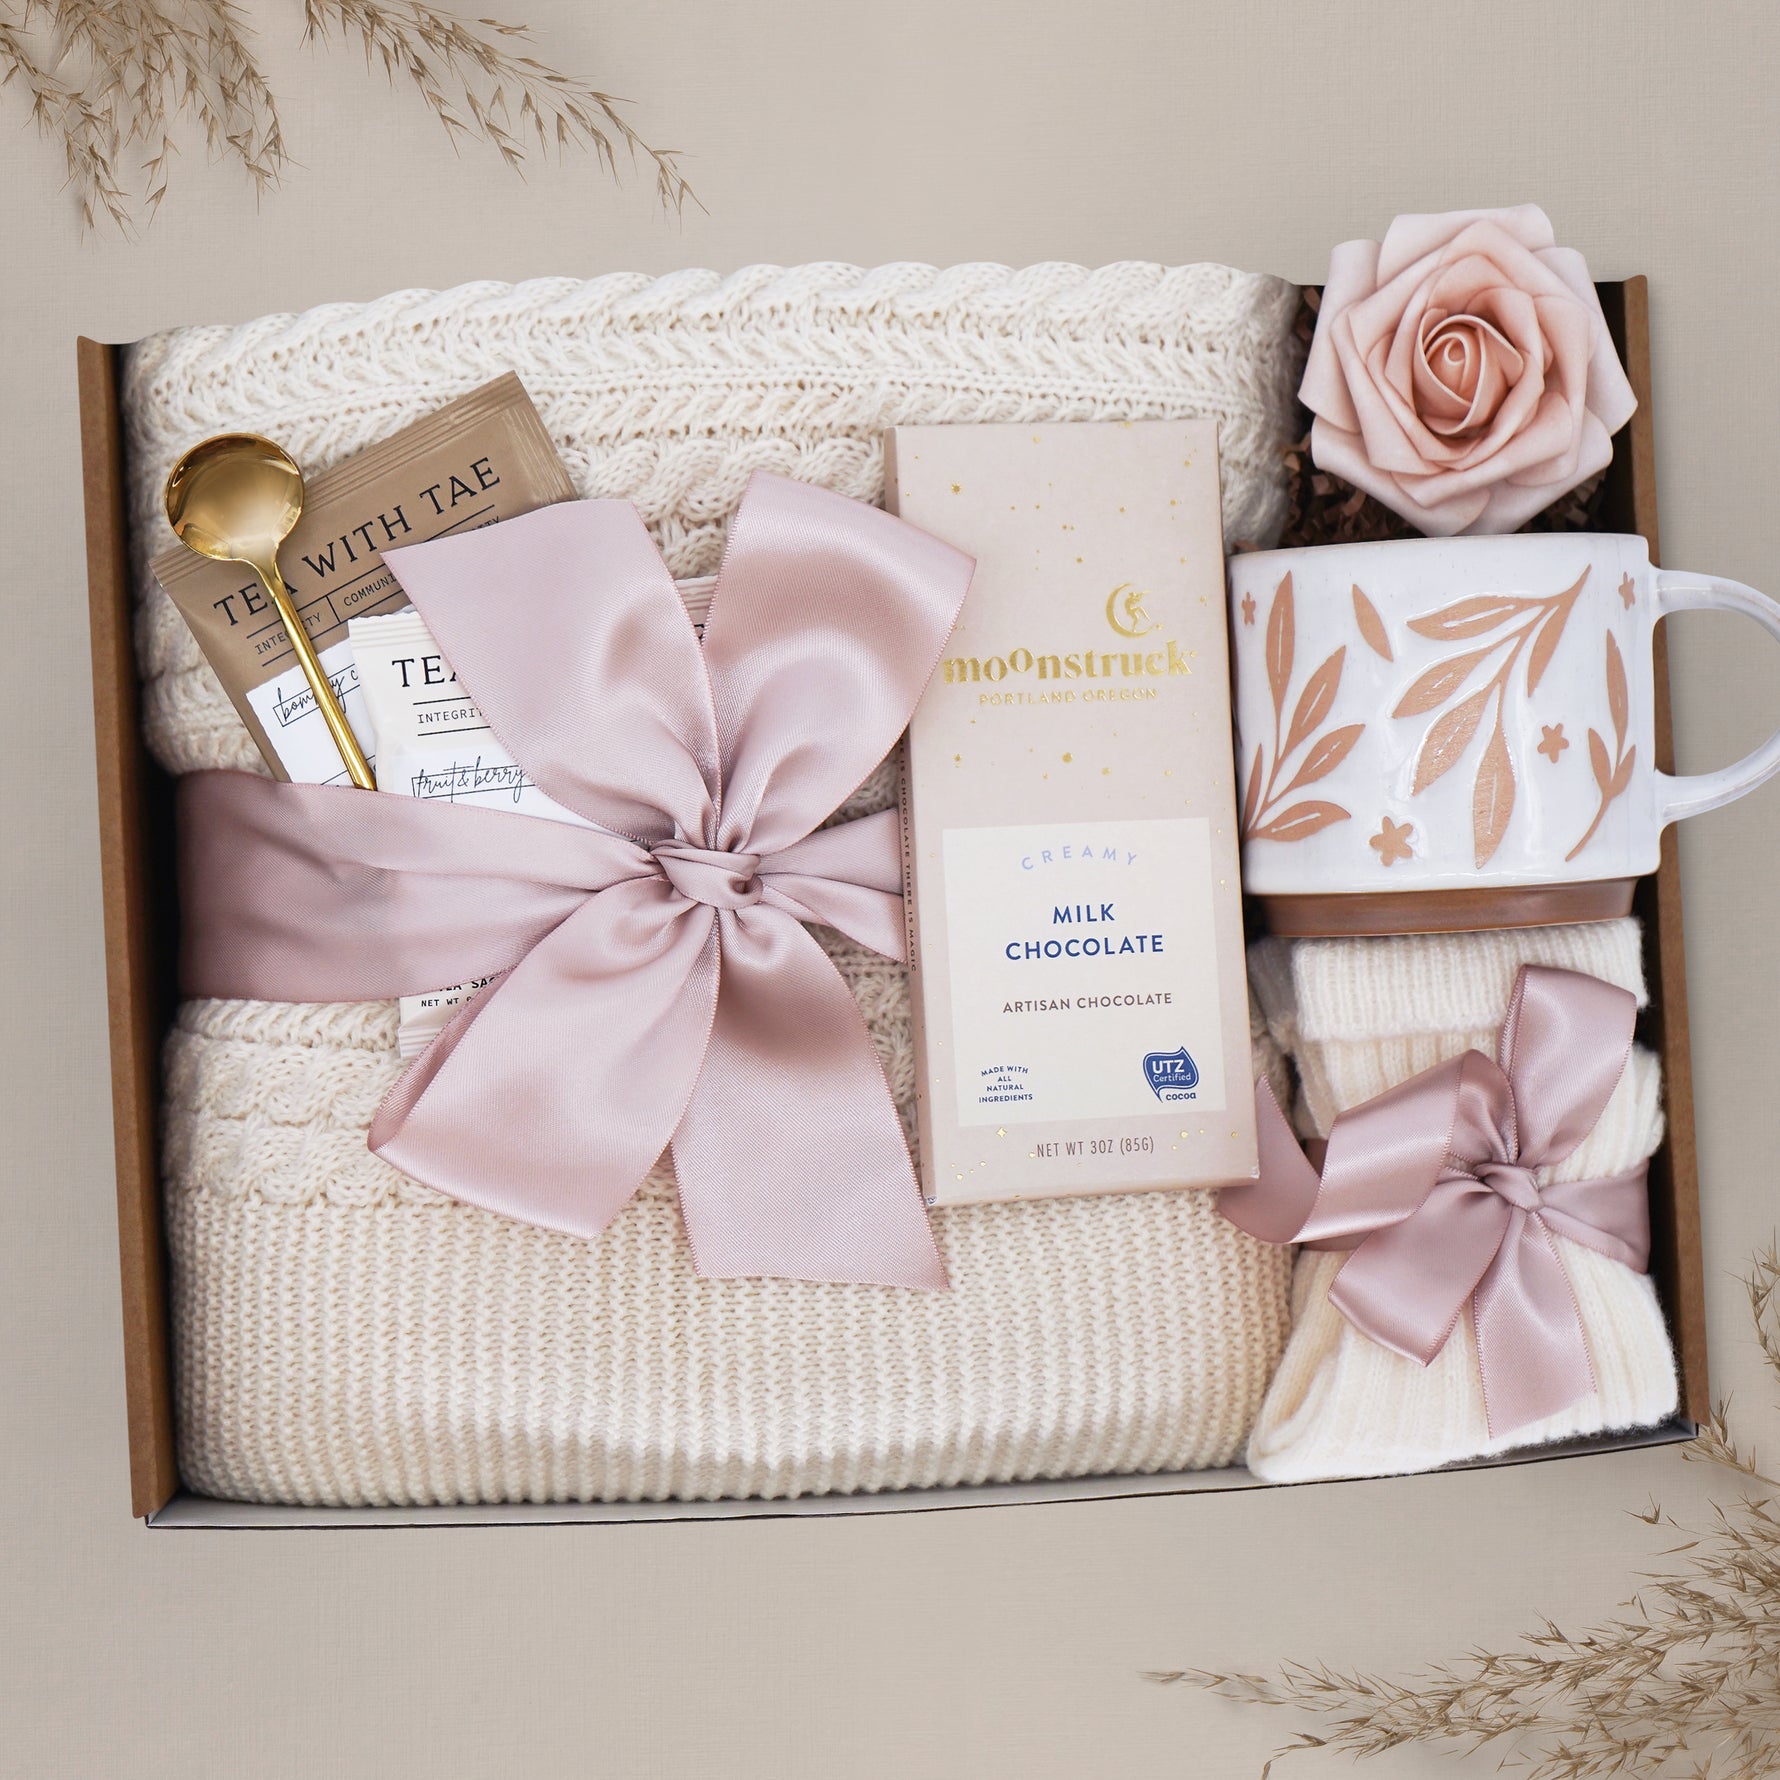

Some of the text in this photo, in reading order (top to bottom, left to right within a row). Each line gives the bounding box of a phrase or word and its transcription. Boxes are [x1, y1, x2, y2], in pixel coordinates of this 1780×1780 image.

[213, 457, 500, 627] TE WITH TAE
[255, 612, 322, 655] INTETY
[392, 655, 457, 688] TE
[942, 639, 1193, 685] moonstruck
[979, 687, 1158, 706] PORTLAND OREGON
[901, 778, 910, 857] CHOCOLATE
[1021, 845, 1137, 870] CREAMY
[905, 863, 913, 905] THERE
[908, 911, 914, 923] IS
[1052, 903, 1116, 925] MILK
[909, 929, 917, 972] MAGIC
[1005, 934, 1164, 961] CHOCOLATE
[421, 999, 440, 1007] NET
[446, 997, 459, 1006] WT
[1003, 993, 1173, 1014] ARTISAN CHOCOLATE
[981, 1065, 1029, 1076] MADE WITH
[1152, 1059, 1185, 1074] UTZ
[1153, 1072, 1191, 1083] Certified
[978, 1093, 1033, 1103] INGREDIENTS
[986, 1084, 1024, 1092] NATURAL
[1165, 1092, 1197, 1101] cocoa
[1037, 1142, 1059, 1158] NET
[1065, 1141, 1084, 1156] WT
[1120, 1135, 1154, 1156] (85G)
